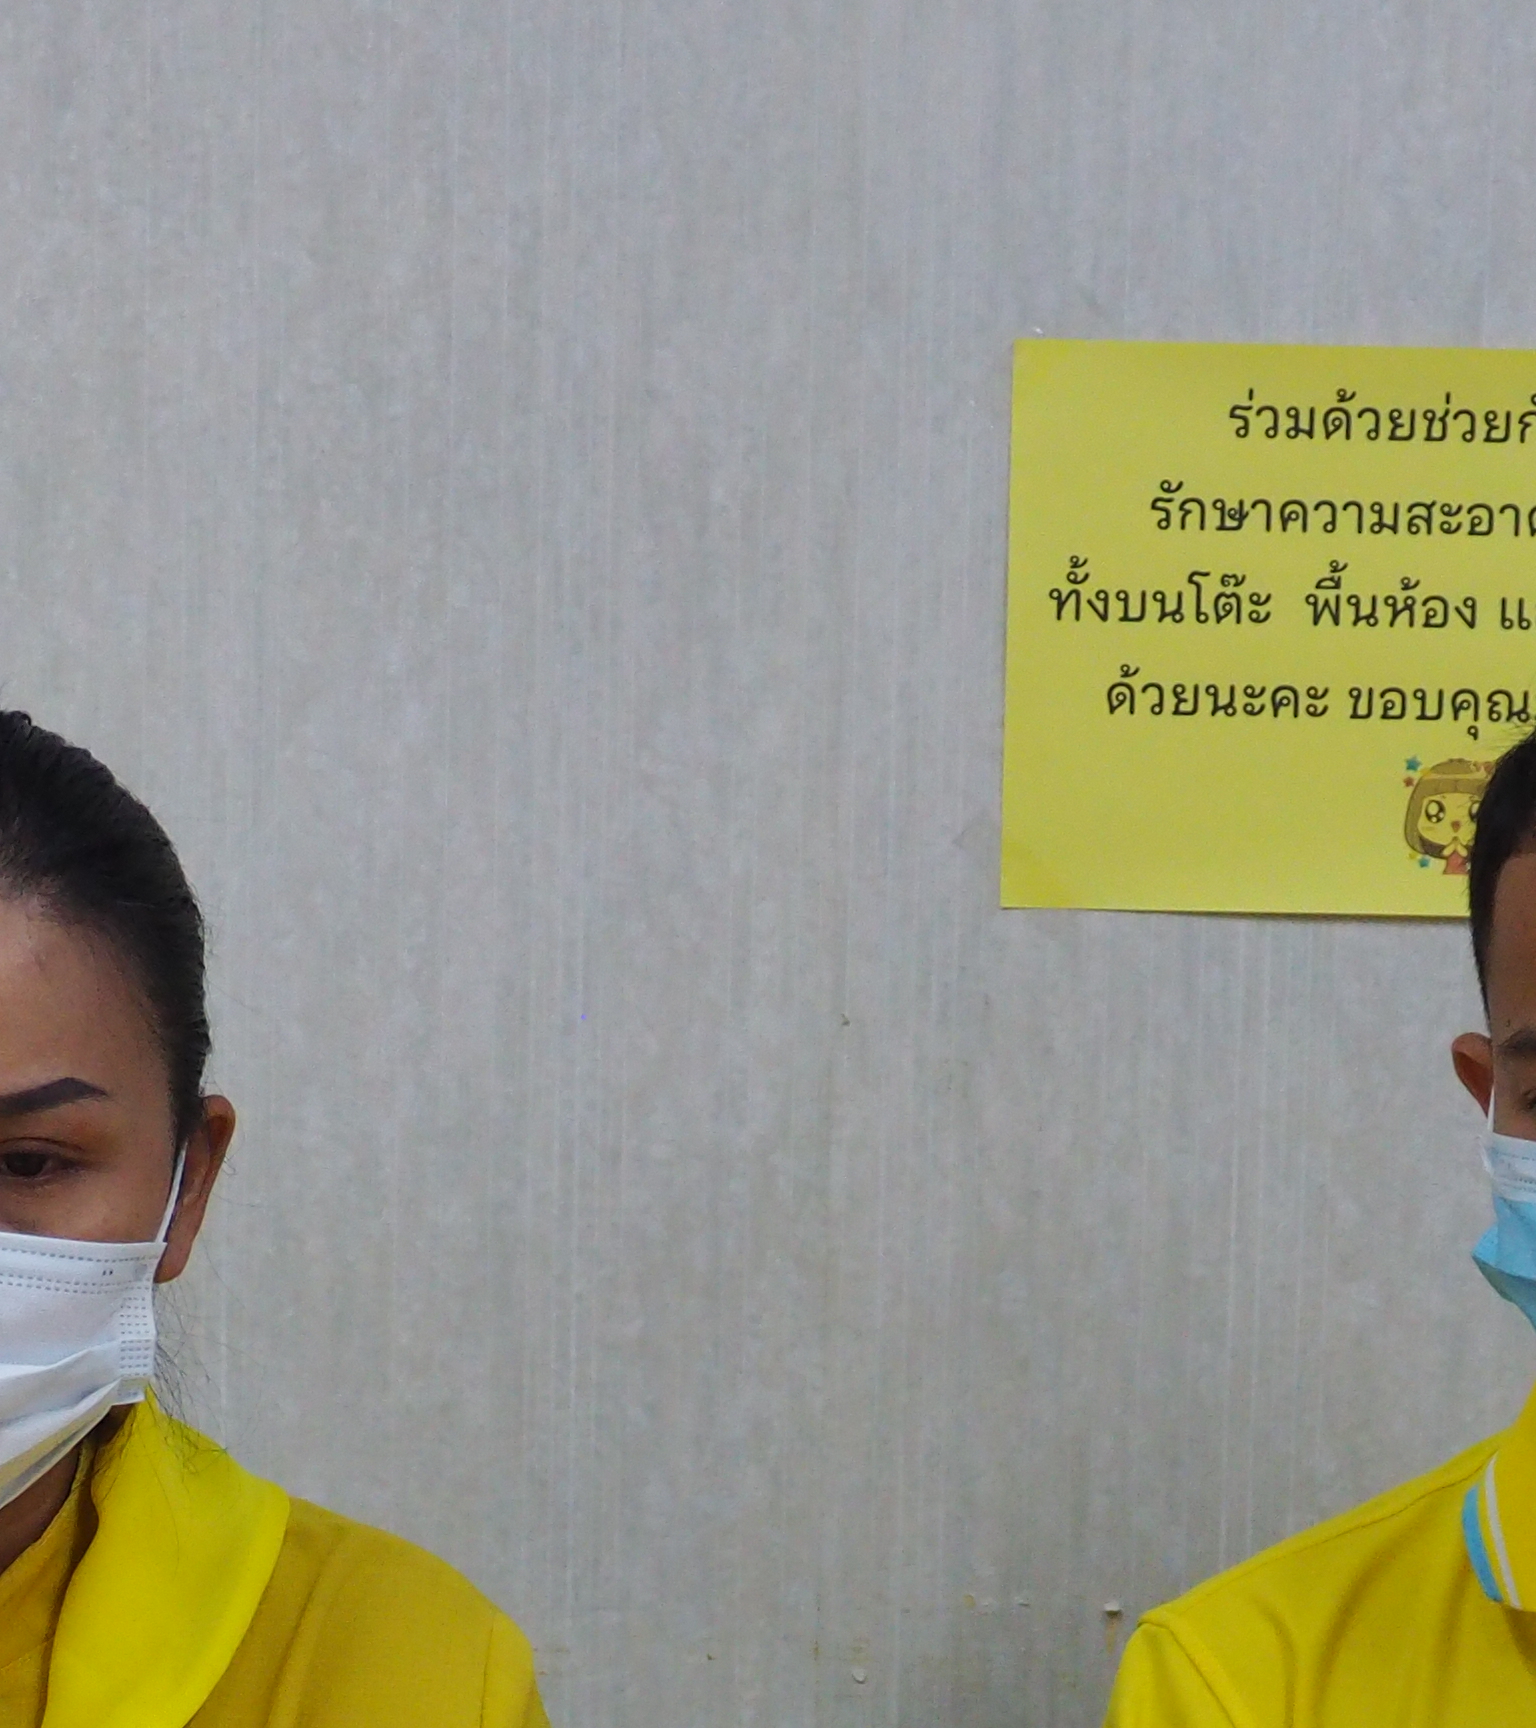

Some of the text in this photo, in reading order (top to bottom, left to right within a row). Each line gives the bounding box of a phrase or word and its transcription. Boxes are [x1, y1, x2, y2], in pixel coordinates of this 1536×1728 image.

[1048, 555, 1273, 626] ทั้งบนโต๊ะ
[1304, 559, 1478, 631] พื้นห้อง
[1105, 663, 1331, 719] ด้วยนะคะ
